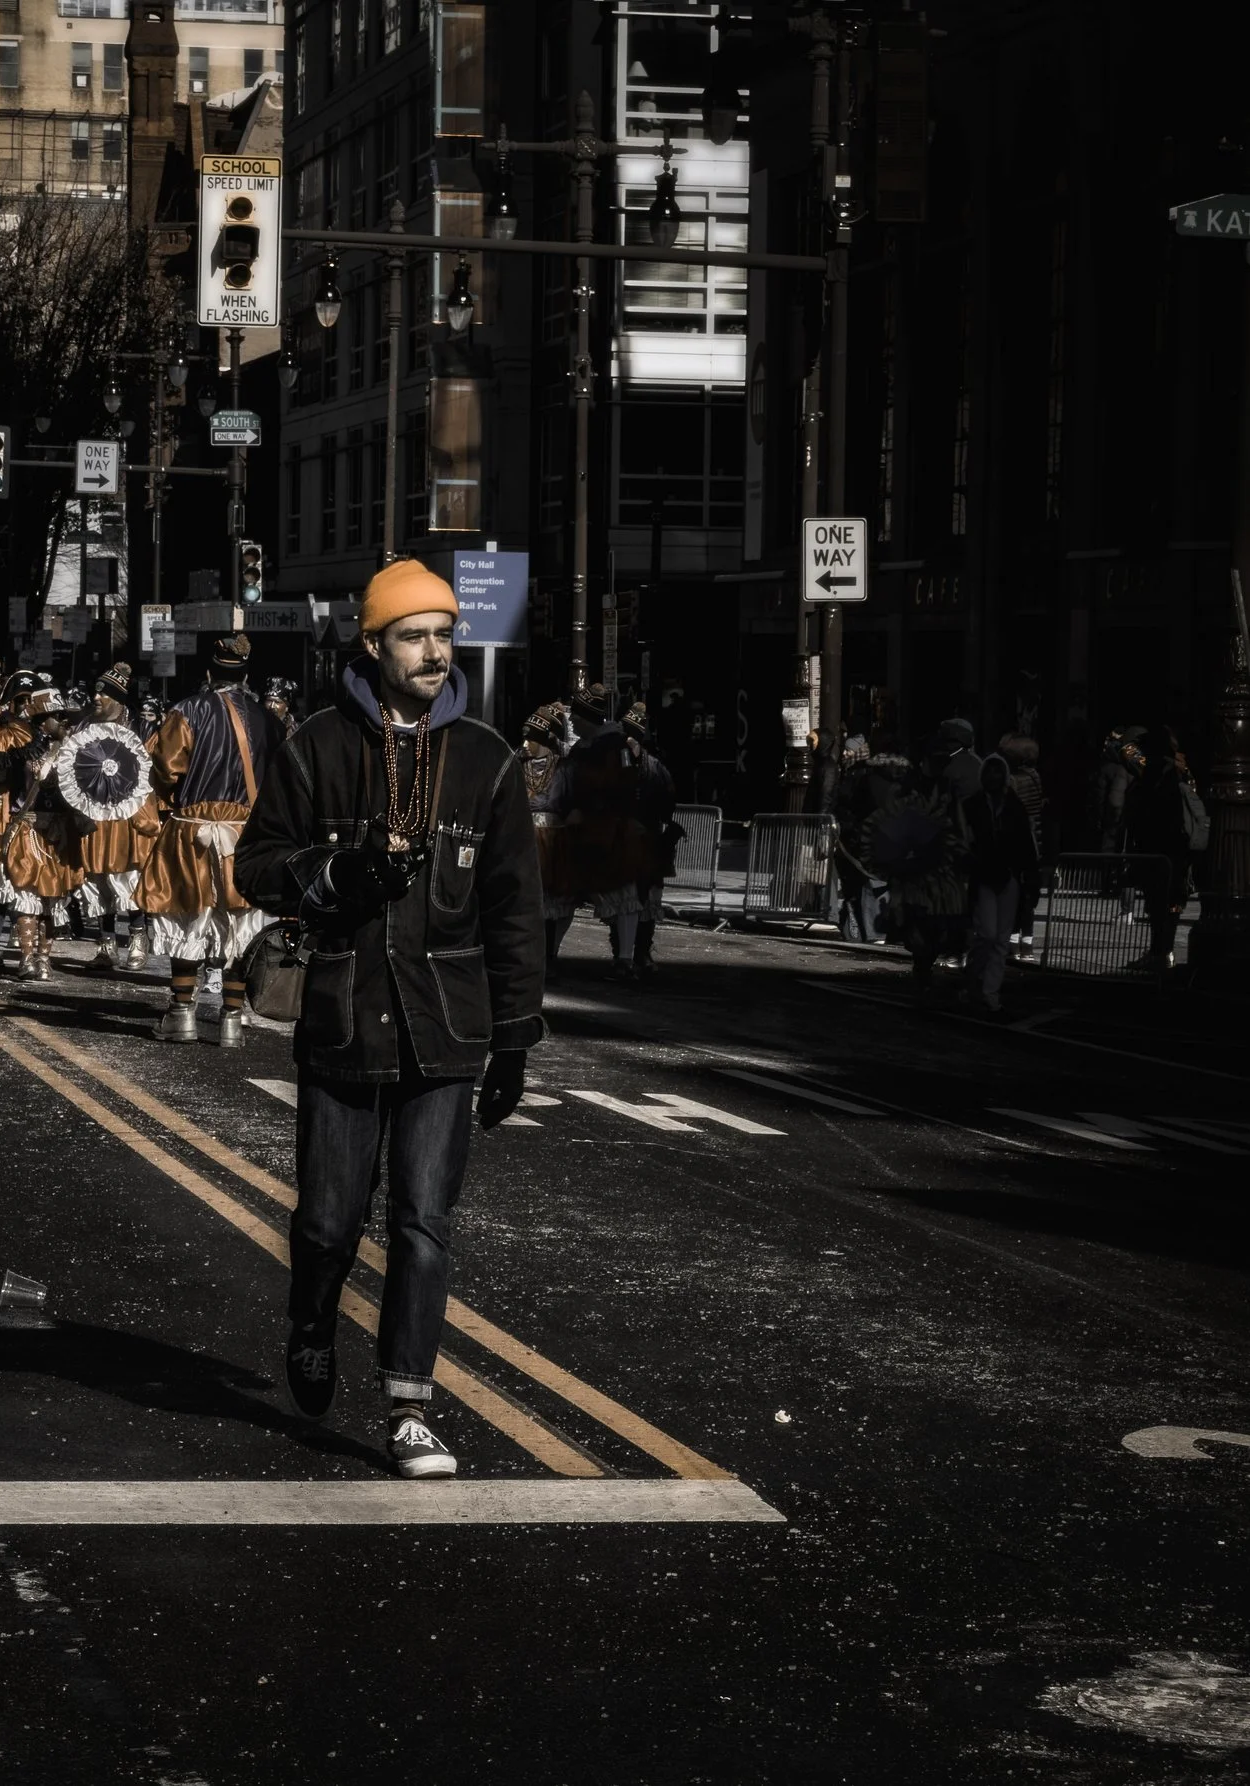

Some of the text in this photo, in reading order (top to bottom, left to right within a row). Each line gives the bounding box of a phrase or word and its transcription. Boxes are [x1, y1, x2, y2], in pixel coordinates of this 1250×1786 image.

[212, 160, 271, 175] SCHOOL
[207, 177, 274, 191] SPEED LIMIT
[220, 295, 257, 308] WHEN
[206, 309, 269, 322] FLASHING
[221, 416, 250, 428] SOUTH
[85, 445, 110, 457] ONE
[84, 459, 110, 471] WAY
[815, 526, 855, 544] ONE
[813, 548, 856, 567] WAY
[459, 560, 495, 569] City Hall
[459, 576, 505, 585] Convention
[459, 585, 487, 594] Center
[459, 601, 497, 610] Rail Park
